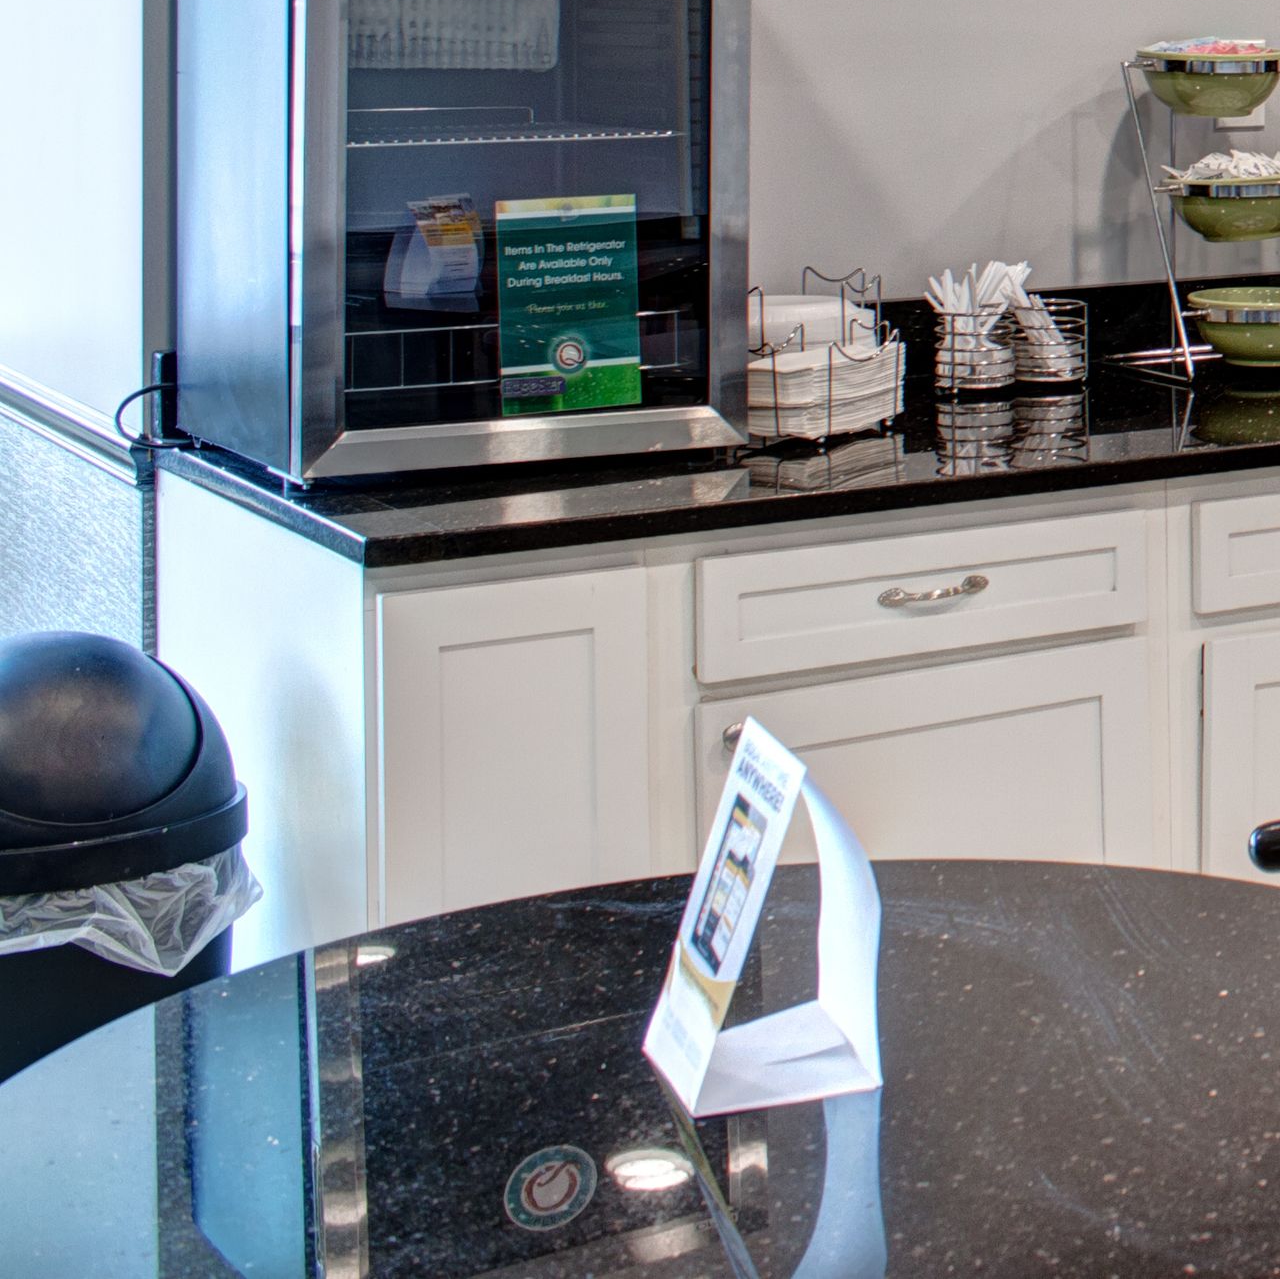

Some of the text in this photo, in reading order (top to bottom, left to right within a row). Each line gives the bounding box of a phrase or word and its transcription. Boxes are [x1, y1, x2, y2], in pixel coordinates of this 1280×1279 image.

[504, 239, 626, 256] Items In The Refrigerator
[518, 256, 614, 271] Are Available Only
[507, 271, 625, 289] During Breakfast Hours.
[736, 755, 786, 815] ANYWHERE!
